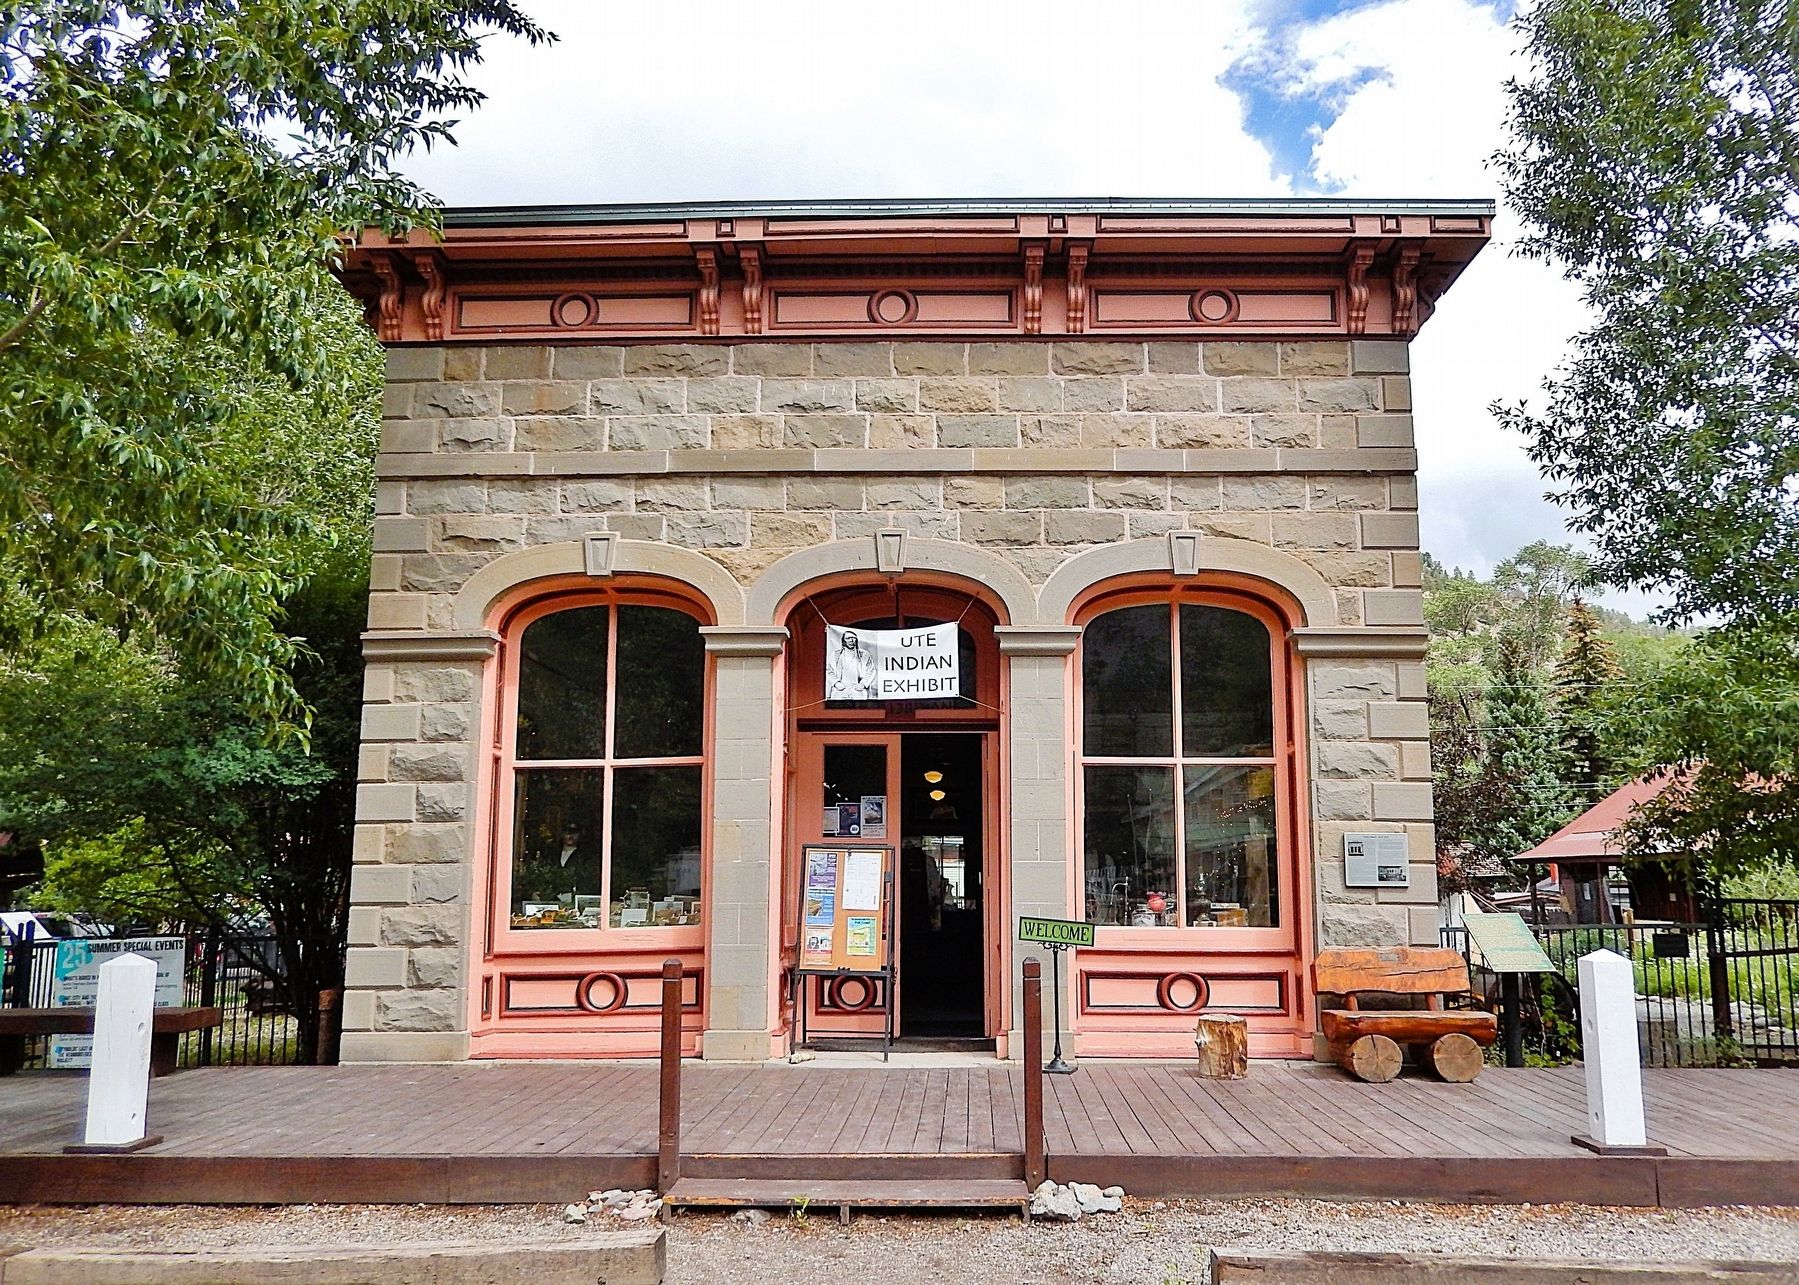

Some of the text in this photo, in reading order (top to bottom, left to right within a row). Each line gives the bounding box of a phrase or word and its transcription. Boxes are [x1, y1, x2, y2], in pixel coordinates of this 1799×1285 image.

[901, 633, 937, 648] UTE
[885, 655, 952, 671] INDIAN
[883, 677, 957, 693] EXHIBIT
[1024, 921, 1090, 942] WELCOME
[88, 939, 184, 953] SUMMER SPECIAL EVENTS
